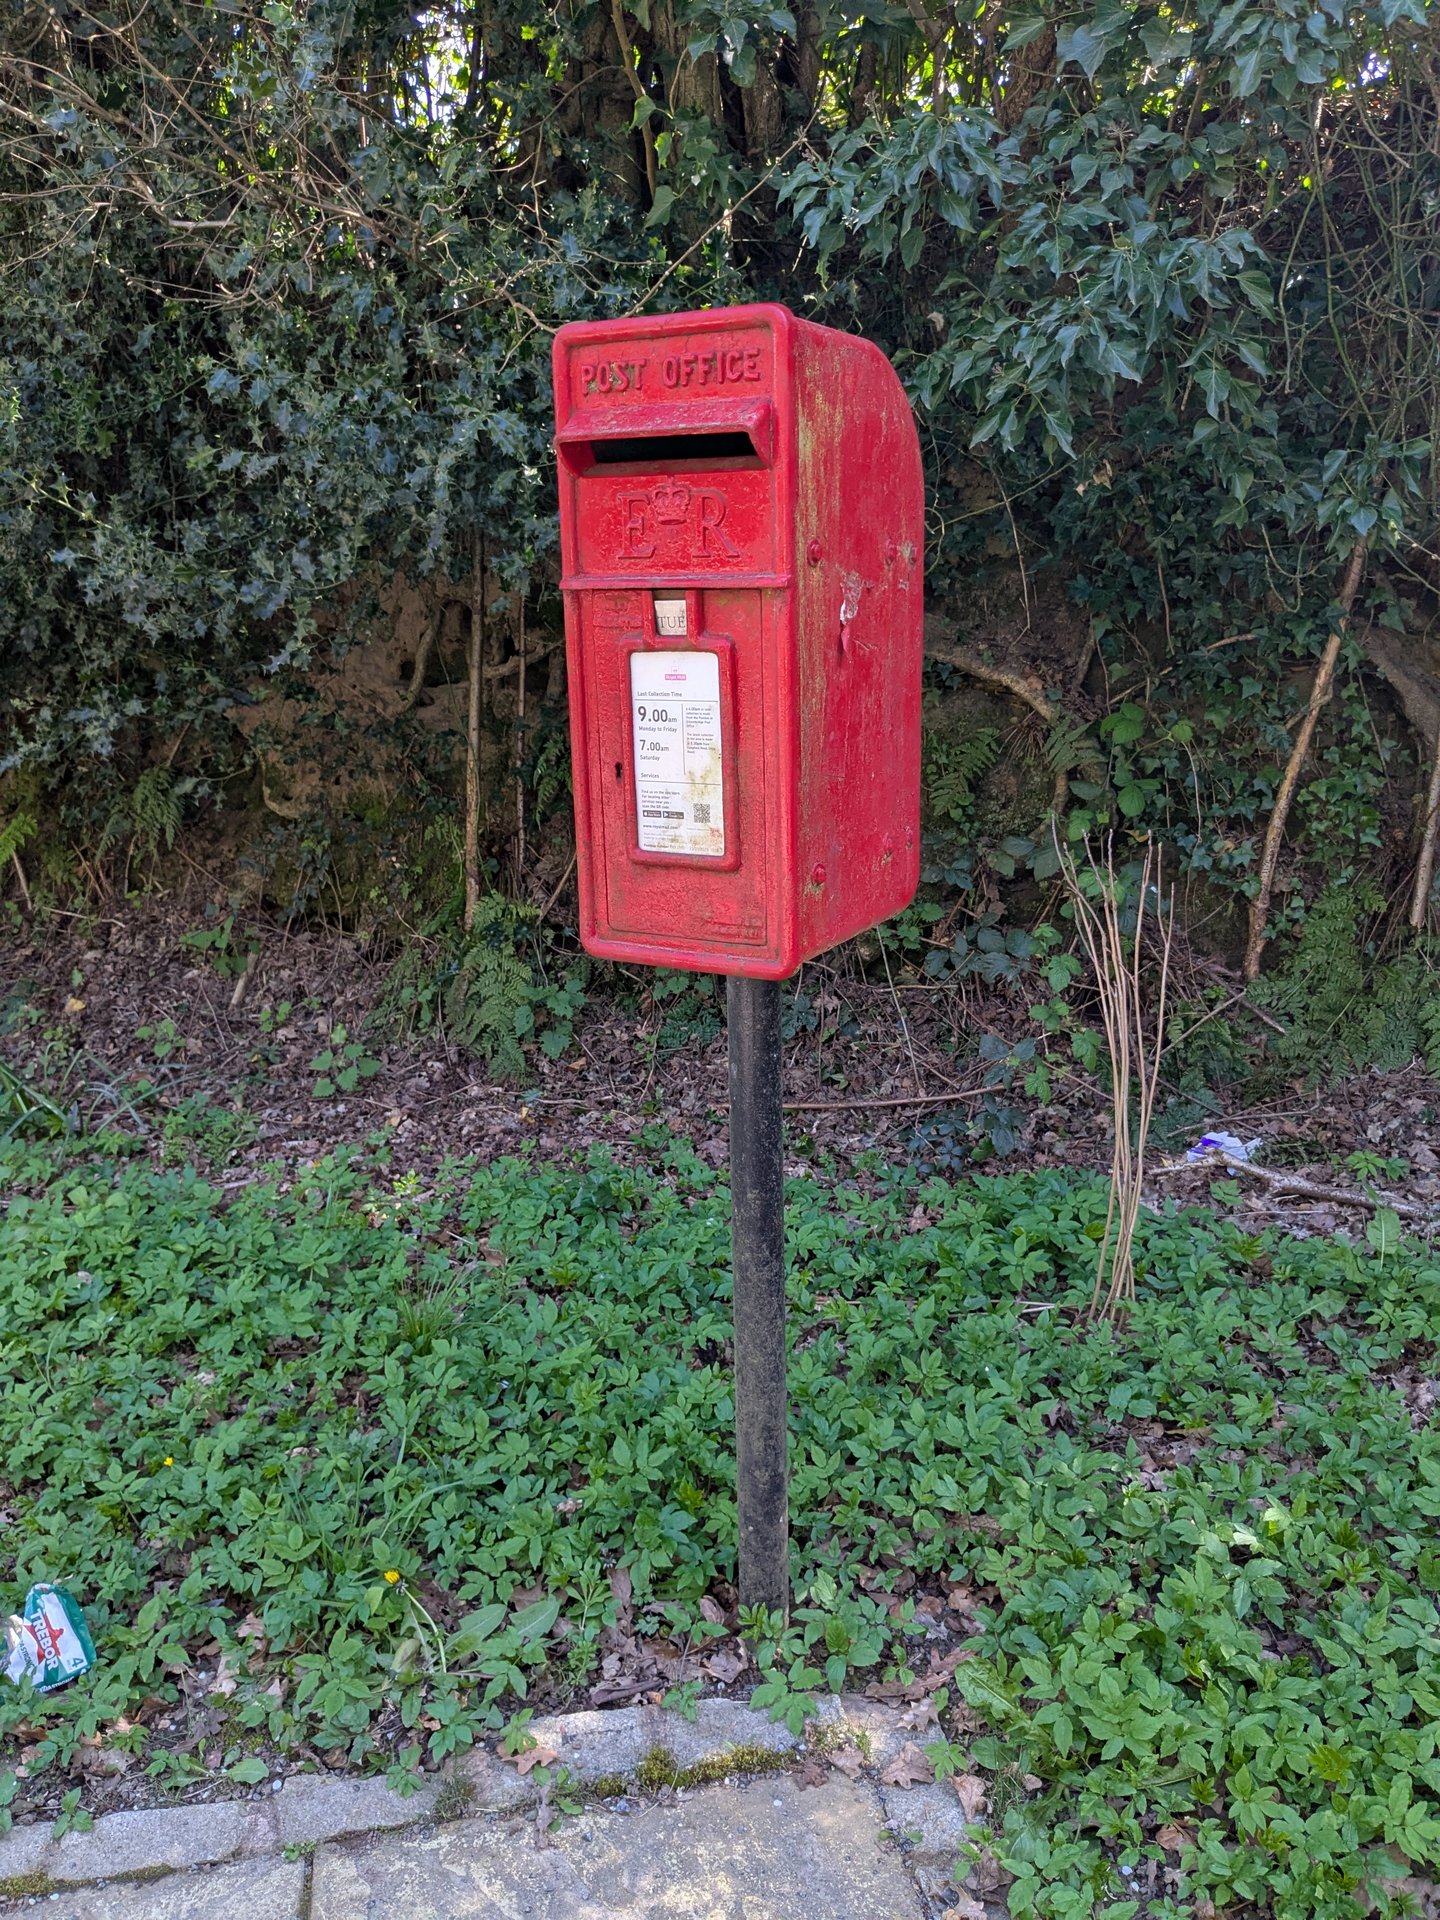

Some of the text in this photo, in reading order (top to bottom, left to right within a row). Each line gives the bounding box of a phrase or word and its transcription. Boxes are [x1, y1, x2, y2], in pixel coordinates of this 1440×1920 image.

[580, 348, 761, 396] POST OFFICE
[617, 487, 740, 560] E R
[657, 616, 686, 629] TUE
[638, 706, 677, 723] 9.00am
[639, 740, 669, 751] 7.00am
[30, 1608, 59, 1671] TREBOR
[72, 1658, 84, 1668] 4
